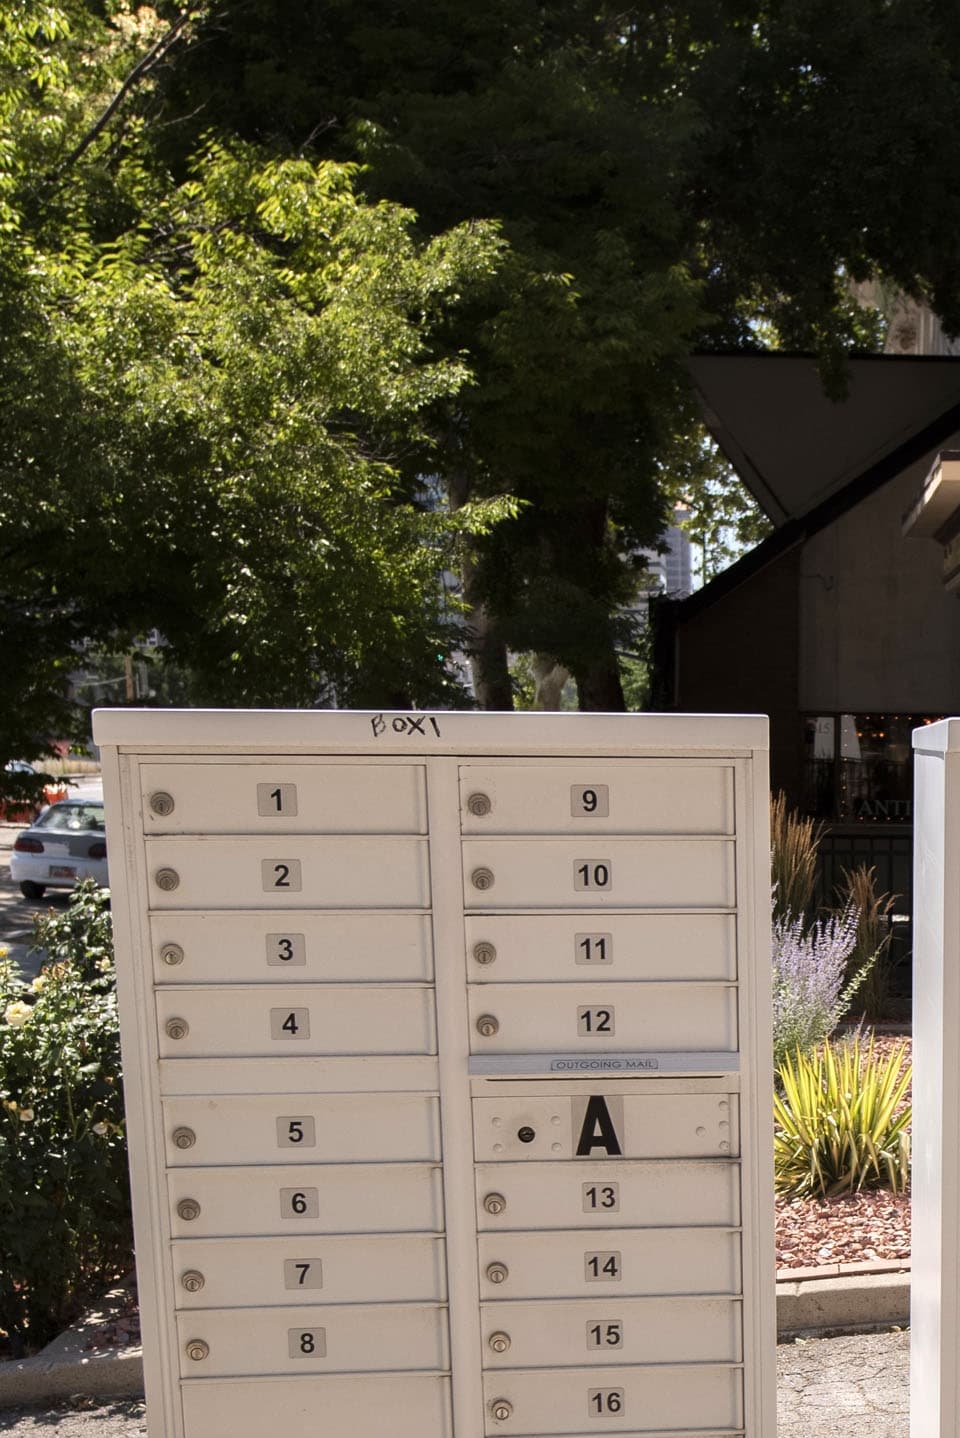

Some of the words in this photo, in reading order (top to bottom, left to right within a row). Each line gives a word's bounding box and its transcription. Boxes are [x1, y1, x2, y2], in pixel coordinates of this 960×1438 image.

[270, 788, 282, 811] 1
[582, 789, 598, 812] 9
[274, 864, 290, 887] 2
[578, 864, 608, 887] 10
[278, 938, 294, 961] 3
[580, 938, 606, 960] 11
[282, 1013, 299, 1035] 4
[580, 1010, 611, 1032] 12
[556, 1061, 622, 1069] OUTGOING
[625, 1060, 654, 1068] MAIL
[288, 1121, 304, 1143] 5
[576, 1094, 622, 1156] A
[291, 1192, 307, 1214] 6
[586, 1187, 616, 1208] 13
[295, 1263, 310, 1285] 7
[588, 1256, 618, 1277] 14
[300, 1332, 315, 1354] 8
[591, 1325, 620, 1345] 15
[592, 1392, 621, 1413] 16
